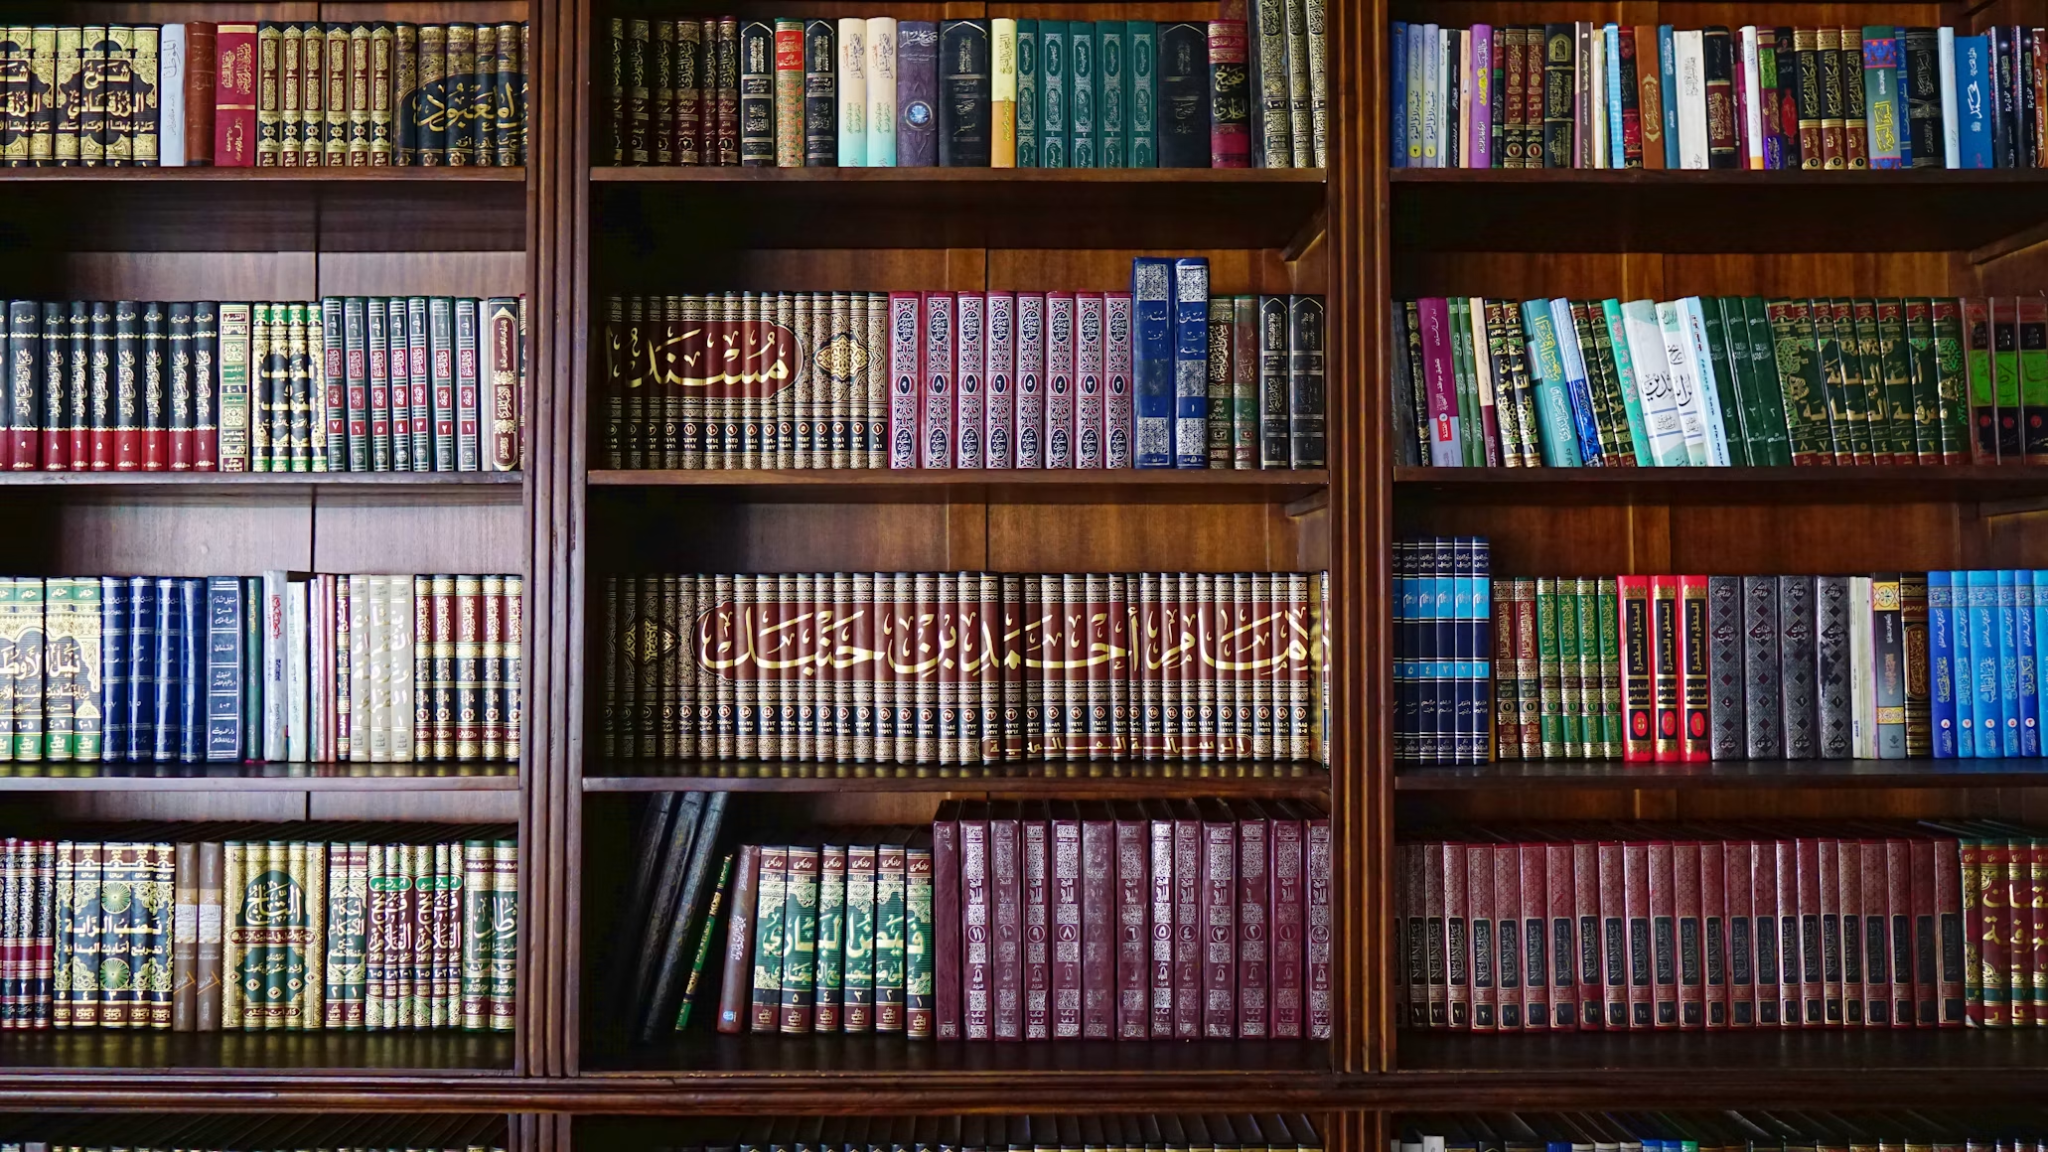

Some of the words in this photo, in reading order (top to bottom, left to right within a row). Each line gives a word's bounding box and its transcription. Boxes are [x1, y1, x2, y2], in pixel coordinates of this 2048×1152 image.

[1214, 65, 1246, 92] صحيح
[67, 90, 145, 119] الزرقاني
[1212, 97, 1247, 121] البخاري
[1874, 100, 1893, 126] السيرة
[1876, 124, 1896, 152] النبوية
[1535, 315, 1555, 351] السيرة
[636, 324, 790, 389] مسند
[1541, 347, 1561, 382] النبوية
[1826, 358, 1883, 387] الغابة
[1802, 397, 1891, 422] الصحابة
[1632, 603, 1643, 633] المتفق
[1662, 603, 1672, 633] المتفق
[1691, 603, 1700, 633] المتفق
[701, 605, 886, 677] حنبل
[49, 643, 80, 679] نيل
[1633, 638, 1644, 671] المفترق
[1663, 638, 1673, 671] المفترق
[1691, 638, 1702, 671] المفترق
[1665, 717, 1673, 730] 2
[245, 880, 303, 926] التاج
[64, 915, 113, 938] الراية
[112, 916, 164, 939] نصب
[762, 912, 854, 958] الباري
[846, 912, 926, 963] فيض
[972, 927, 983, 940] ١١
[1032, 928, 1041, 941] ٩
[1062, 927, 1074, 940] ٨
[1127, 927, 1137, 941] ٦
[1158, 926, 1168, 938] ٥
[1183, 928, 1193, 941] ٤
[1214, 928, 1225, 941] ٣
[1248, 926, 1258, 938] ٢
[1285, 927, 1291, 940] ١
[770, 959, 828, 983] البخاري
[331, 985, 338, 998] ٢
[792, 992, 800, 1004] ٥
[823, 992, 831, 1003] ٤
[854, 990, 863, 1002] ٣
[885, 989, 893, 1001] ٢
[915, 996, 923, 1008] ١
